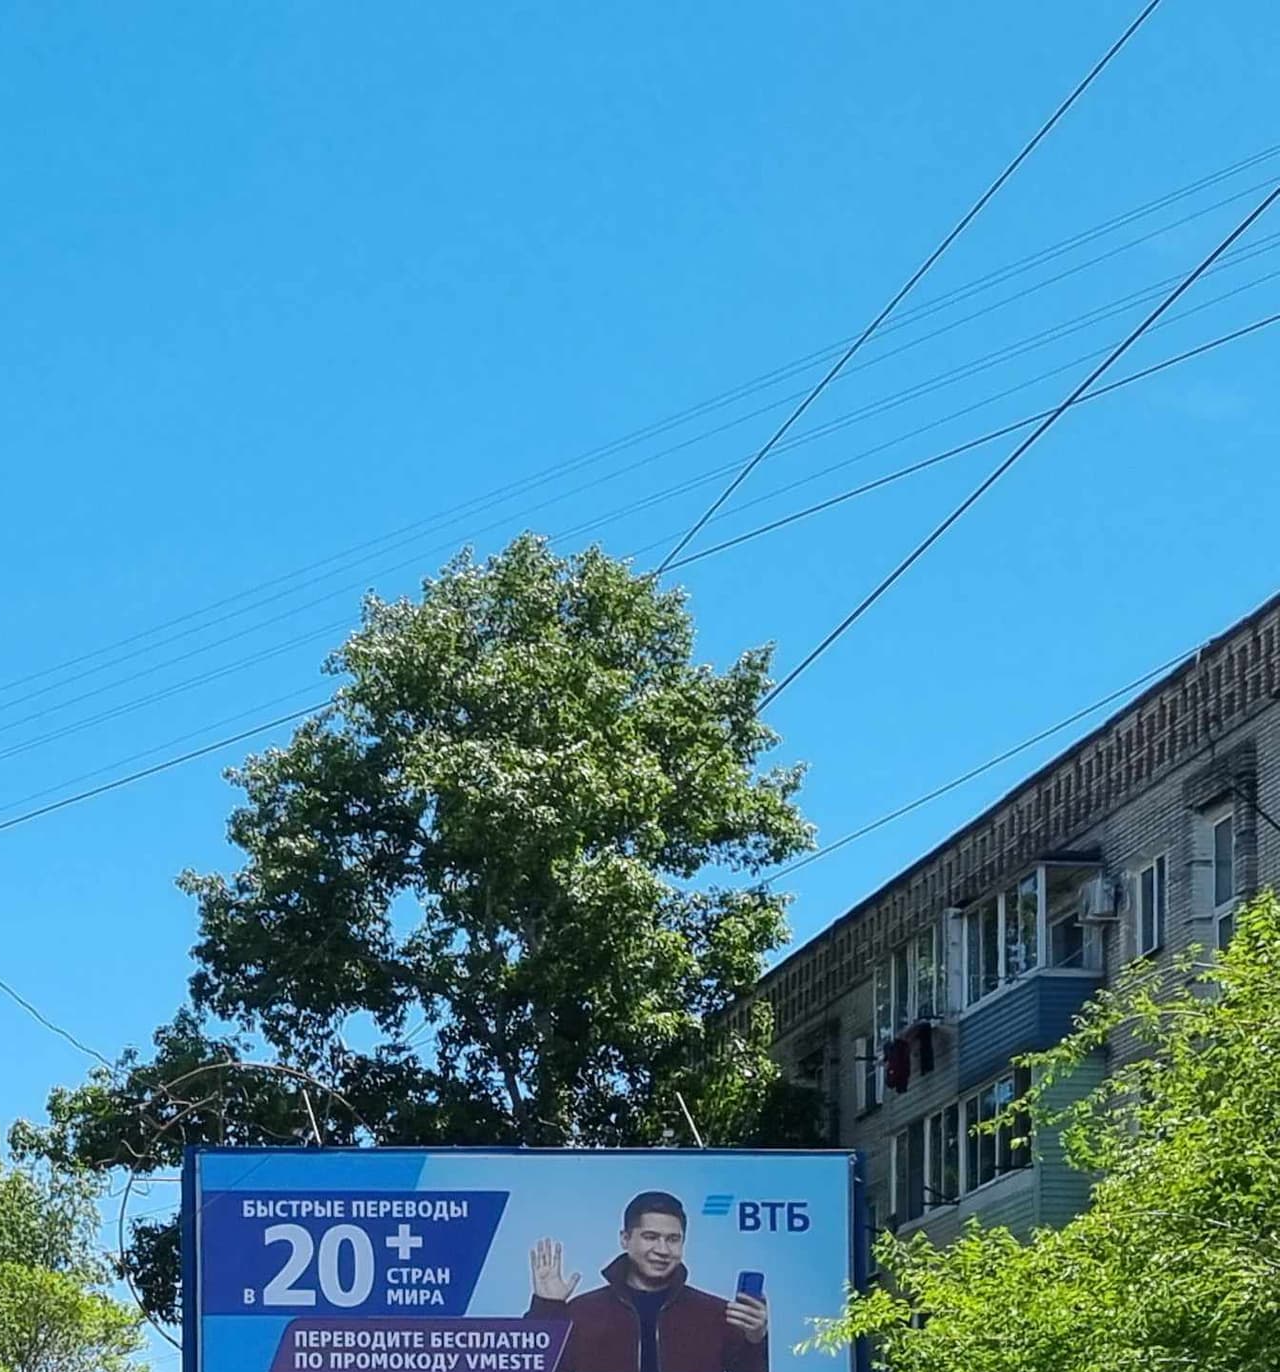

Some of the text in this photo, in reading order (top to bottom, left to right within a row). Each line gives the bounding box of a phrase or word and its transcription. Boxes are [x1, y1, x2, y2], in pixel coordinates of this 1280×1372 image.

[243, 1200, 469, 1221] БЫСТРЫЕ ПЕРЕВОДЫ
[739, 1202, 810, 1232] ВТБ
[386, 1268, 450, 1285] СТРАН
[386, 1289, 445, 1306] МИРА
[294, 1330, 551, 1351] ПЕРЕВОДИТЕ БЕСПЛАТНО
[294, 1352, 545, 1372] ПО ПРОМОКОДУ VMESTE
